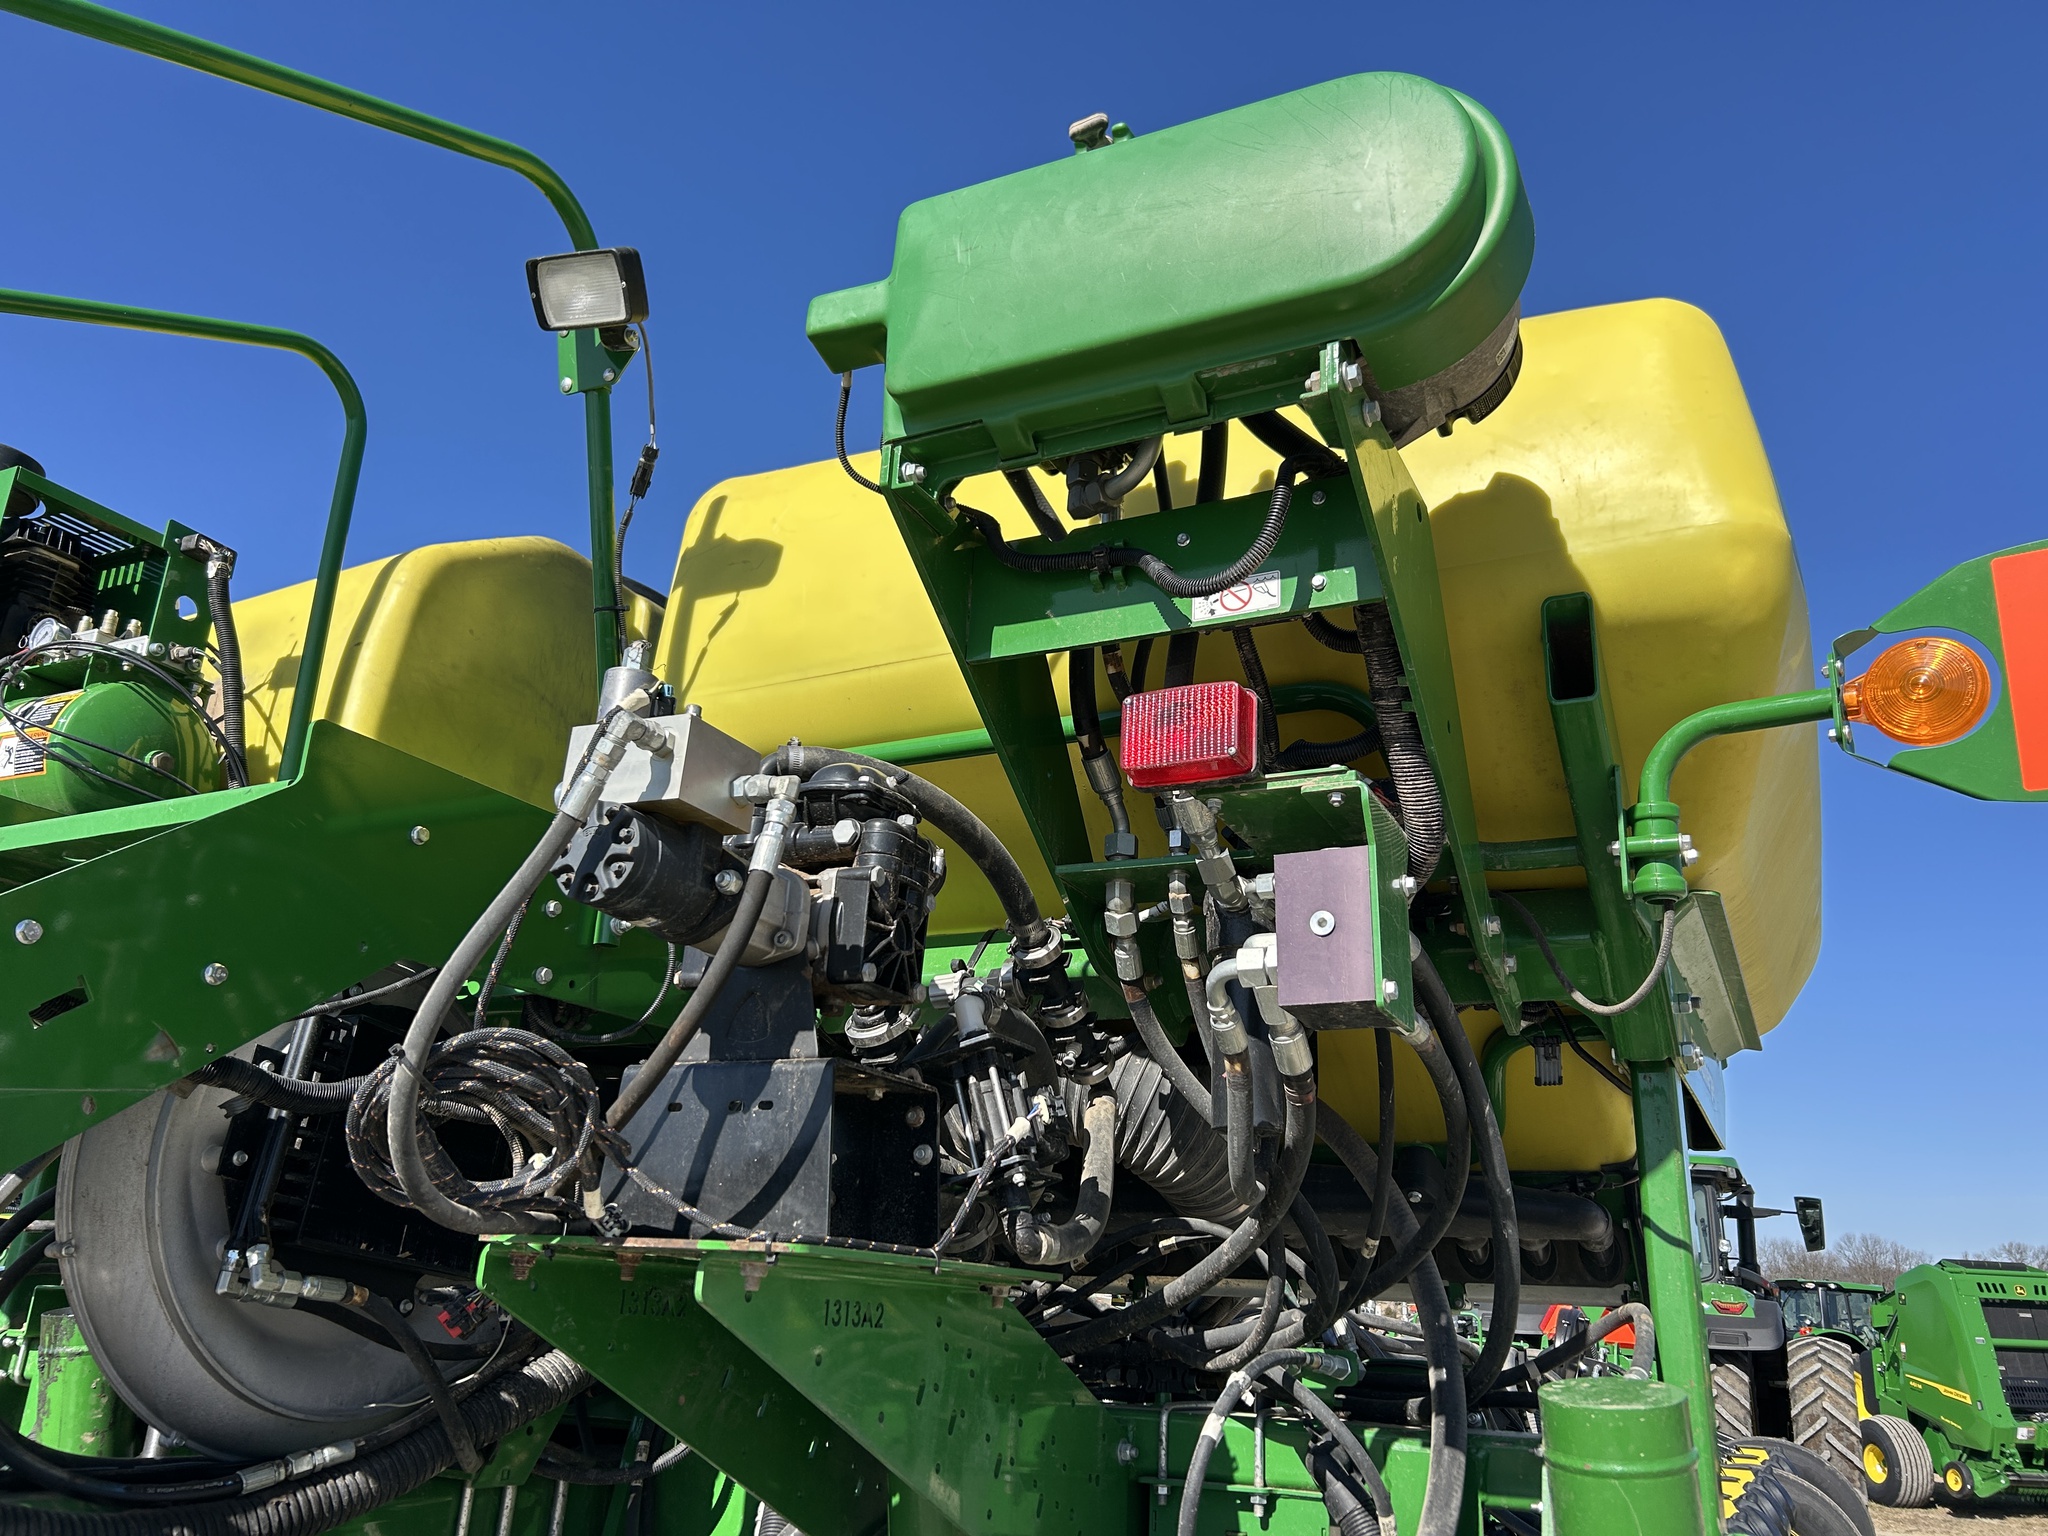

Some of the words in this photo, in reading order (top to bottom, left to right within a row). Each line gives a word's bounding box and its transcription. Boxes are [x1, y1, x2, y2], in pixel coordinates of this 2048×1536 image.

[620, 1288, 688, 1318] 1313A2
[823, 1299, 885, 1329] 1313A2
[1953, 1391, 1967, 1400] DEERE
